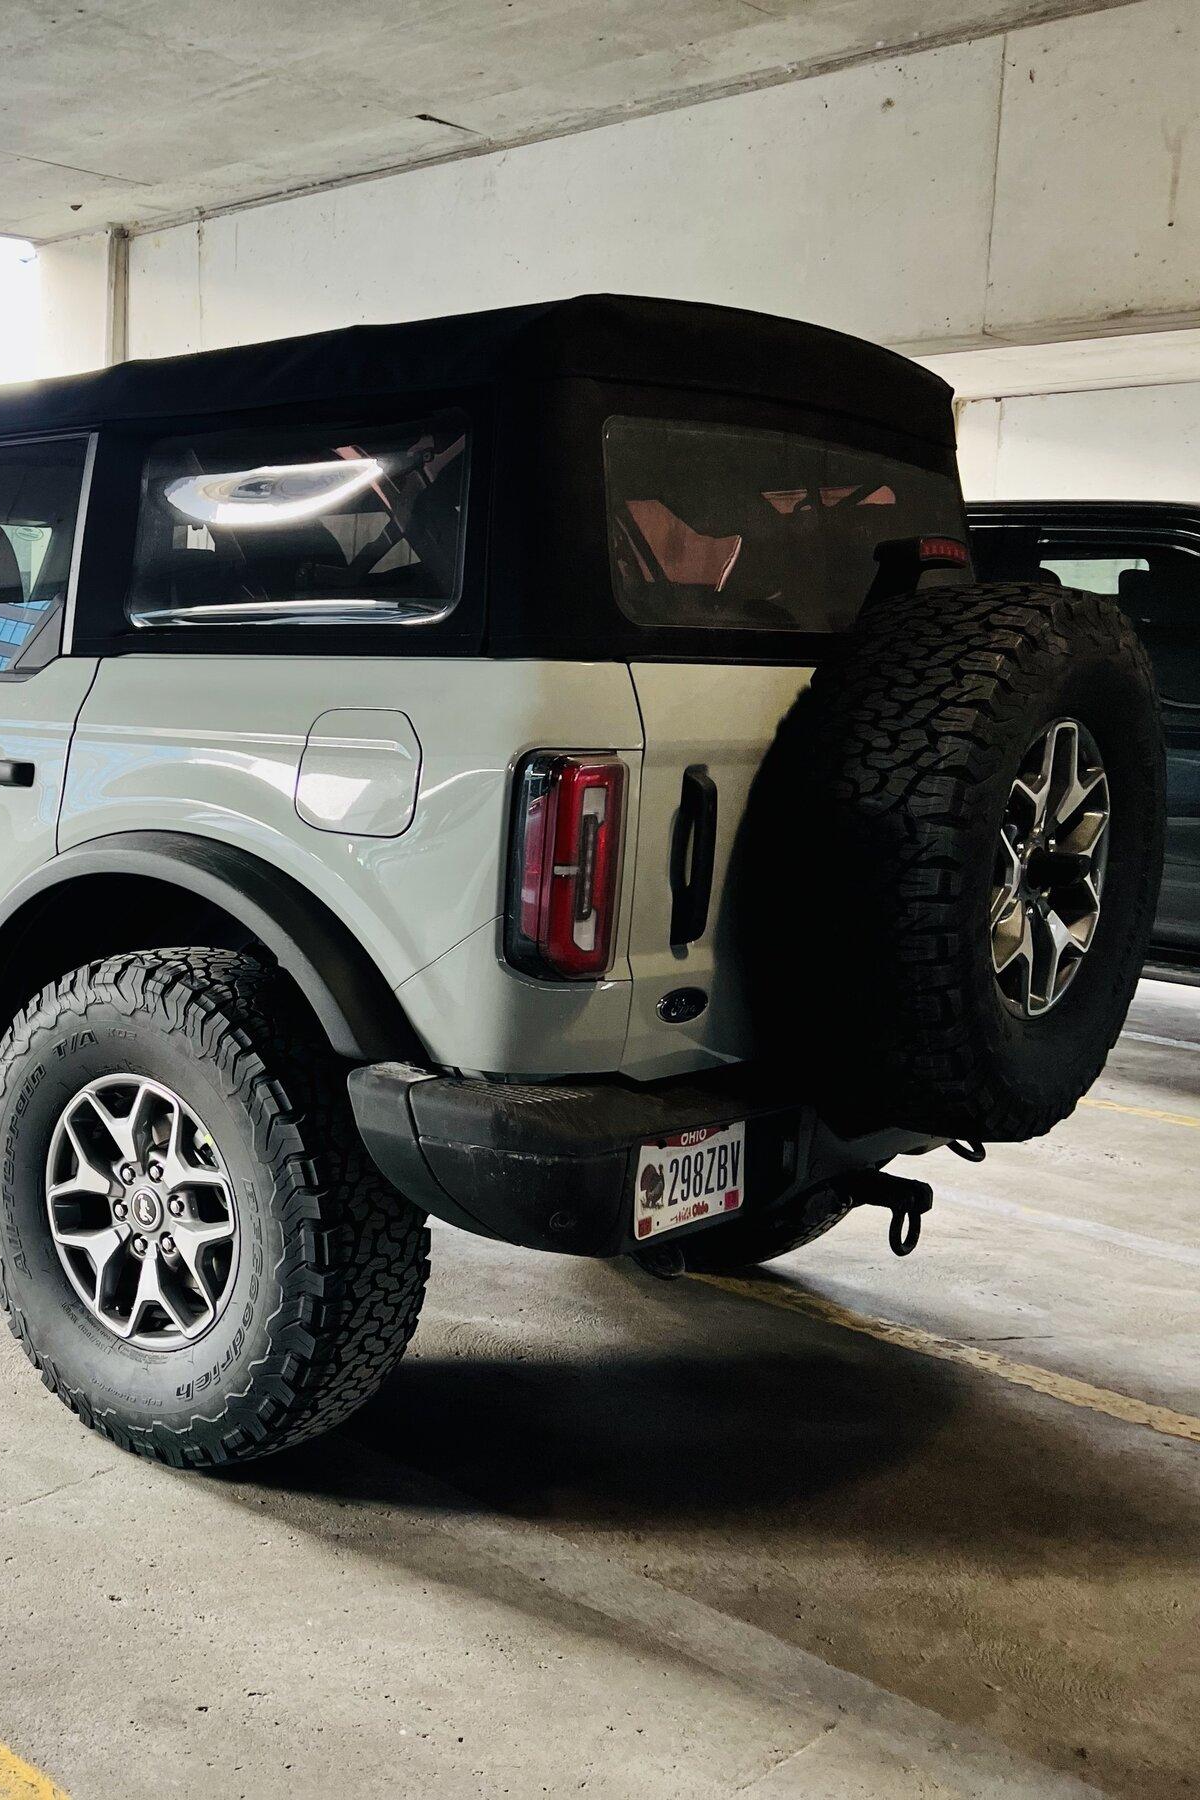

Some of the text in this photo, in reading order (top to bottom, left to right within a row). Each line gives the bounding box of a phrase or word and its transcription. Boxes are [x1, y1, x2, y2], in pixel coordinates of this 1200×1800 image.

[52, 1029, 99, 1061] T/A
[680, 1128, 707, 1146] OHIO
[667, 1140, 741, 1207] 298ZBV
